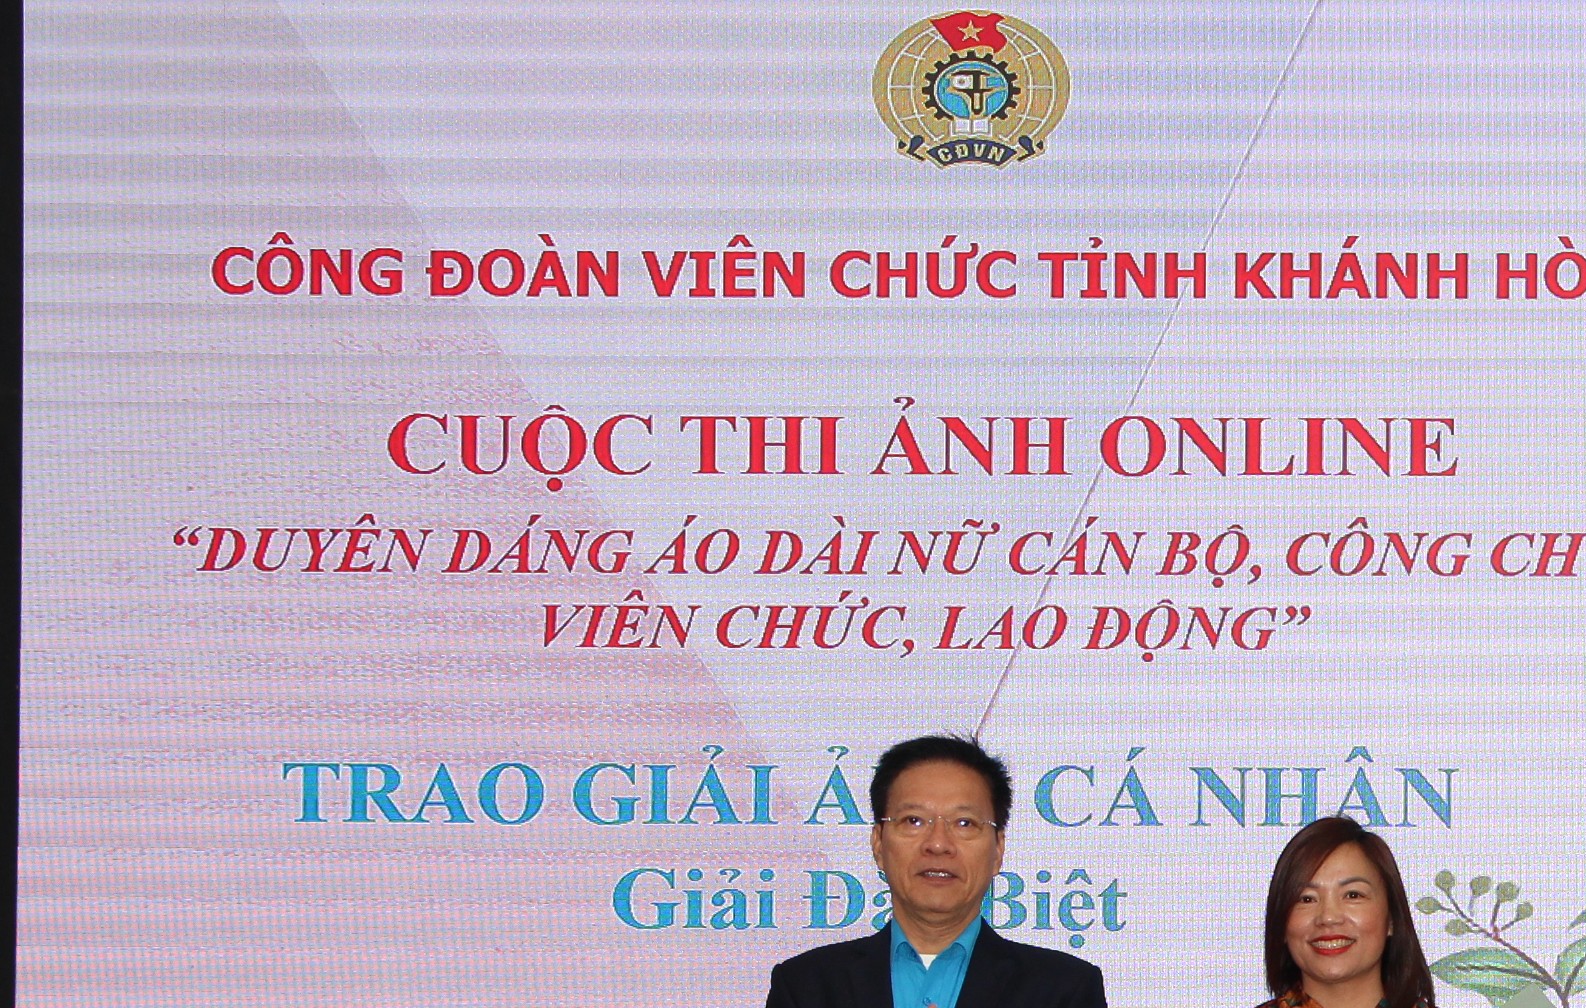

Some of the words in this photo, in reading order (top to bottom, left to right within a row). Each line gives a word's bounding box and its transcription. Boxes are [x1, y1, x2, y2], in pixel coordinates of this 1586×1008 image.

[211, 231, 404, 297] CÔNG
[425, 233, 620, 298] ĐOÀN
[642, 234, 806, 299] VIÊN
[829, 235, 1018, 300] CHỨC
[1037, 236, 1207, 300] TỈNH
[1234, 235, 1470, 300] KHÁNH
[387, 404, 654, 493] CUỘC
[680, 414, 846, 476] THI
[870, 396, 1073, 476] ẢNH
[1100, 415, 1459, 477] ONLINE
[442, 513, 634, 576] DÁNG
[645, 513, 741, 576] ÁO
[753, 514, 881, 576] DÀI
[887, 518, 1000, 576] NỮ
[1008, 516, 1145, 577] CÁN
[1156, 523, 1262, 588] BỘ,
[1286, 516, 1473, 577] CÔNG
[542, 588, 701, 650] VIÊN
[716, 590, 915, 658] CHỨC,
[932, 605, 1069, 651] LAO
[282, 762, 545, 826] TRAO
[572, 744, 779, 827] GIẢI
[1033, 746, 1163, 828] CÁ
[1189, 746, 1460, 829] NHÂN
[612, 868, 778, 931] Giải
[982, 867, 1128, 949] Biệt
